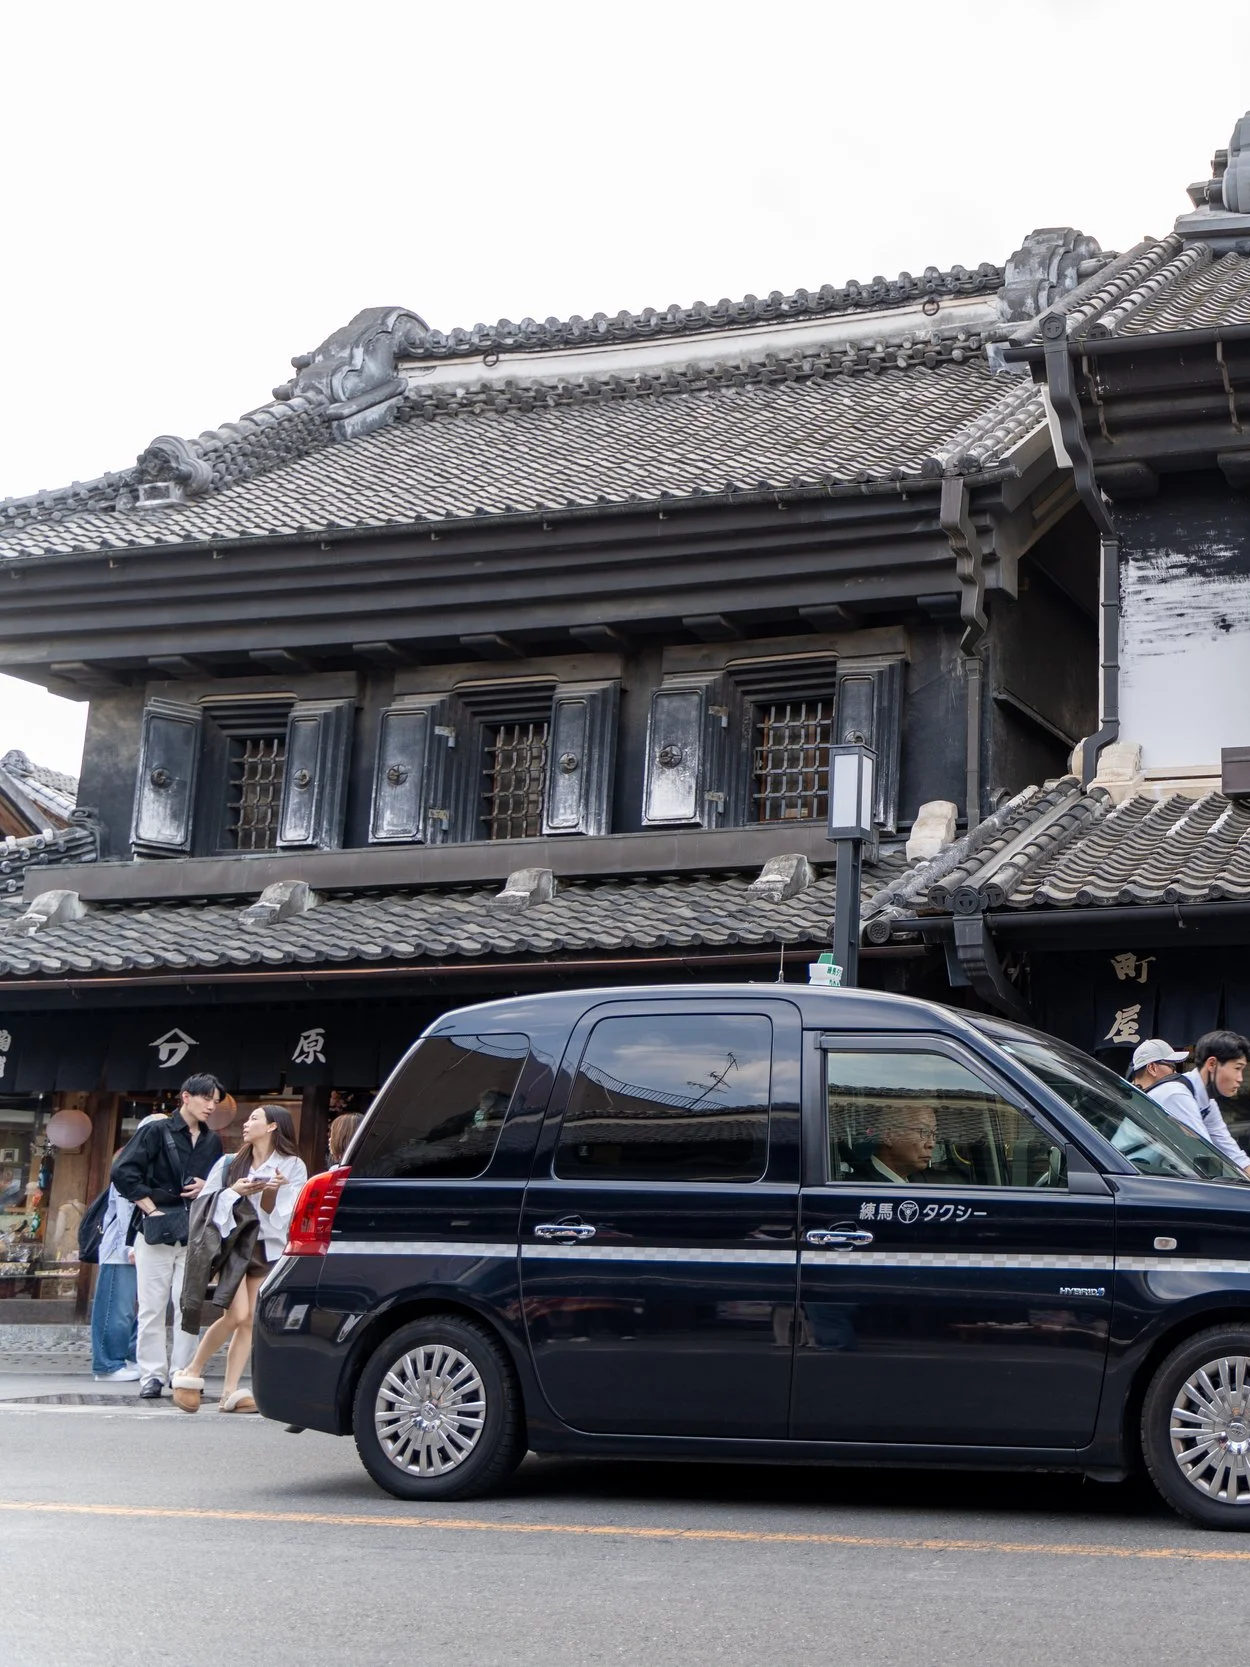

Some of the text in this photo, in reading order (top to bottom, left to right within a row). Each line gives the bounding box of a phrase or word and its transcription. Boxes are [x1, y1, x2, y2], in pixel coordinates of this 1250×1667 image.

[1104, 952, 1156, 1043] 町屋
[292, 1028, 326, 1064] 原
[859, 1202, 987, 1221] 練馬 タクシー
[1060, 1287, 1098, 1296] HYBRID
